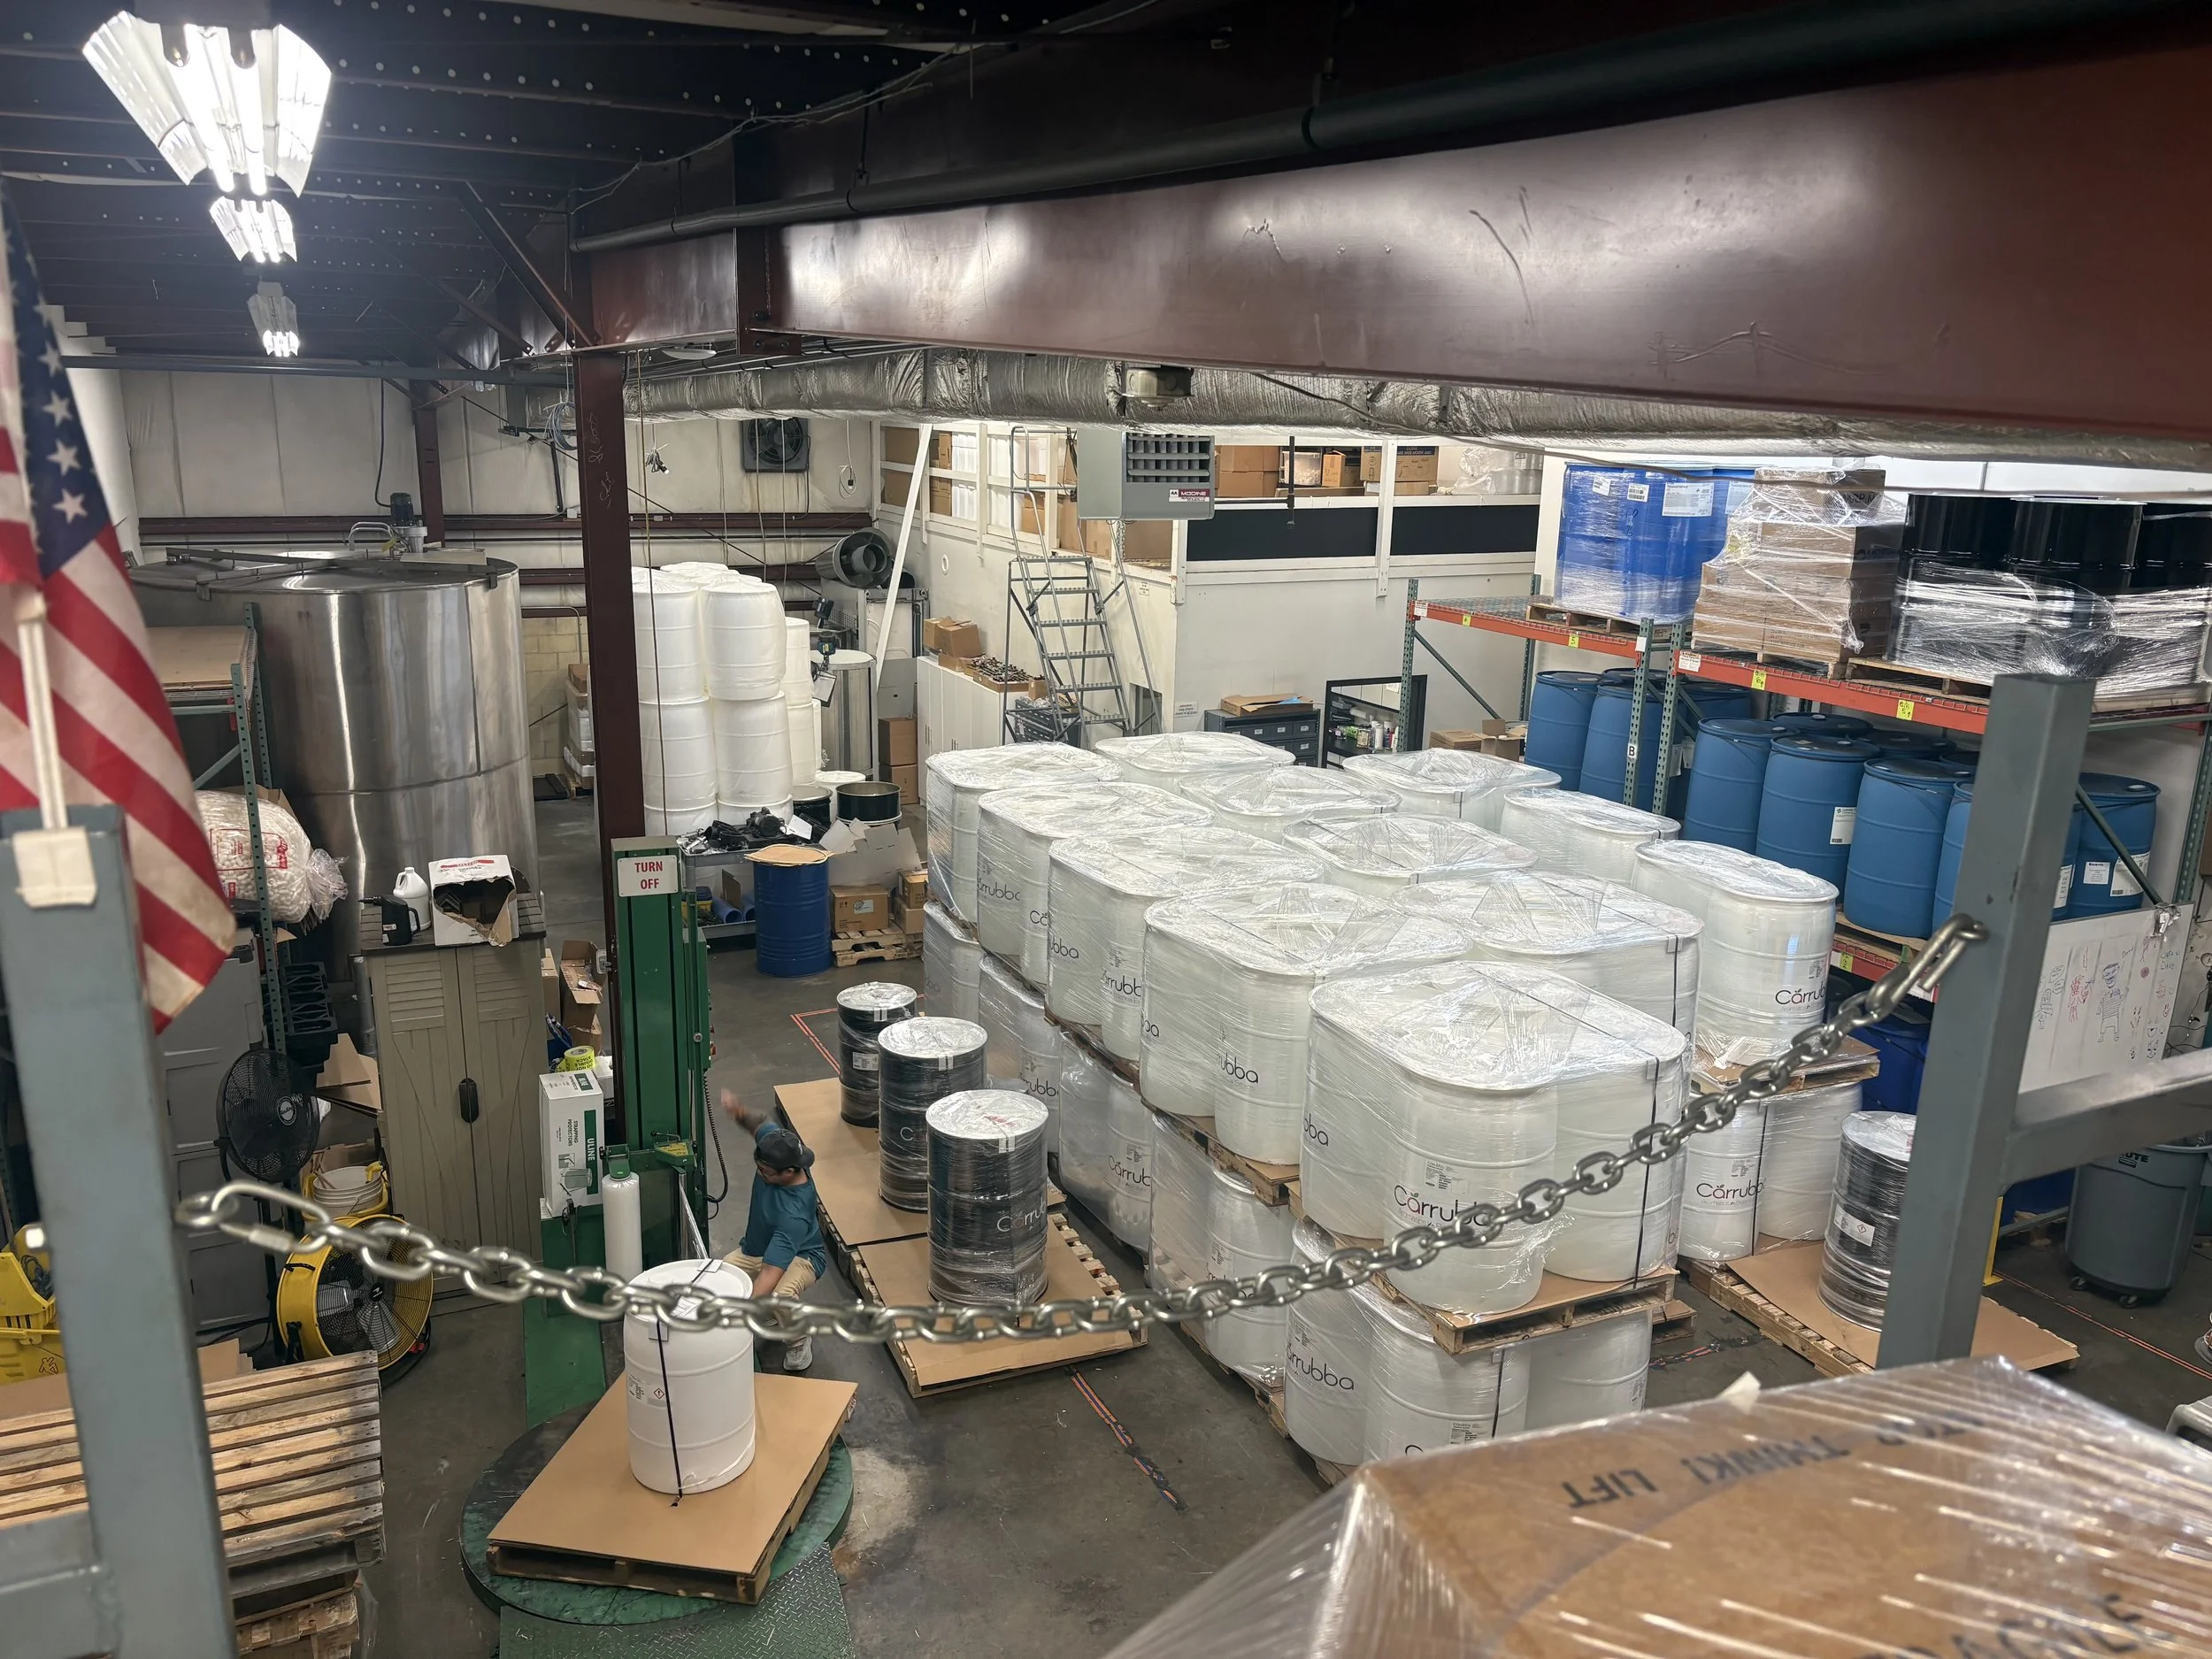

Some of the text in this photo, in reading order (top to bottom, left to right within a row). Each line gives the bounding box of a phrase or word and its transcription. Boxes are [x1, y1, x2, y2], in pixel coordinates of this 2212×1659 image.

[1629, 745, 1635, 757] B
[634, 861, 663, 873] TURN
[640, 879, 659, 890] OFF
[1775, 980, 1826, 1004] Carrub
[587, 1138, 595, 1161] ULINE
[1108, 1155, 1151, 1187] Carrub
[1286, 1342, 1355, 1390] arrubba
[1680, 1434, 1852, 1486] THINK!
[1561, 1468, 1659, 1509] LIFT
